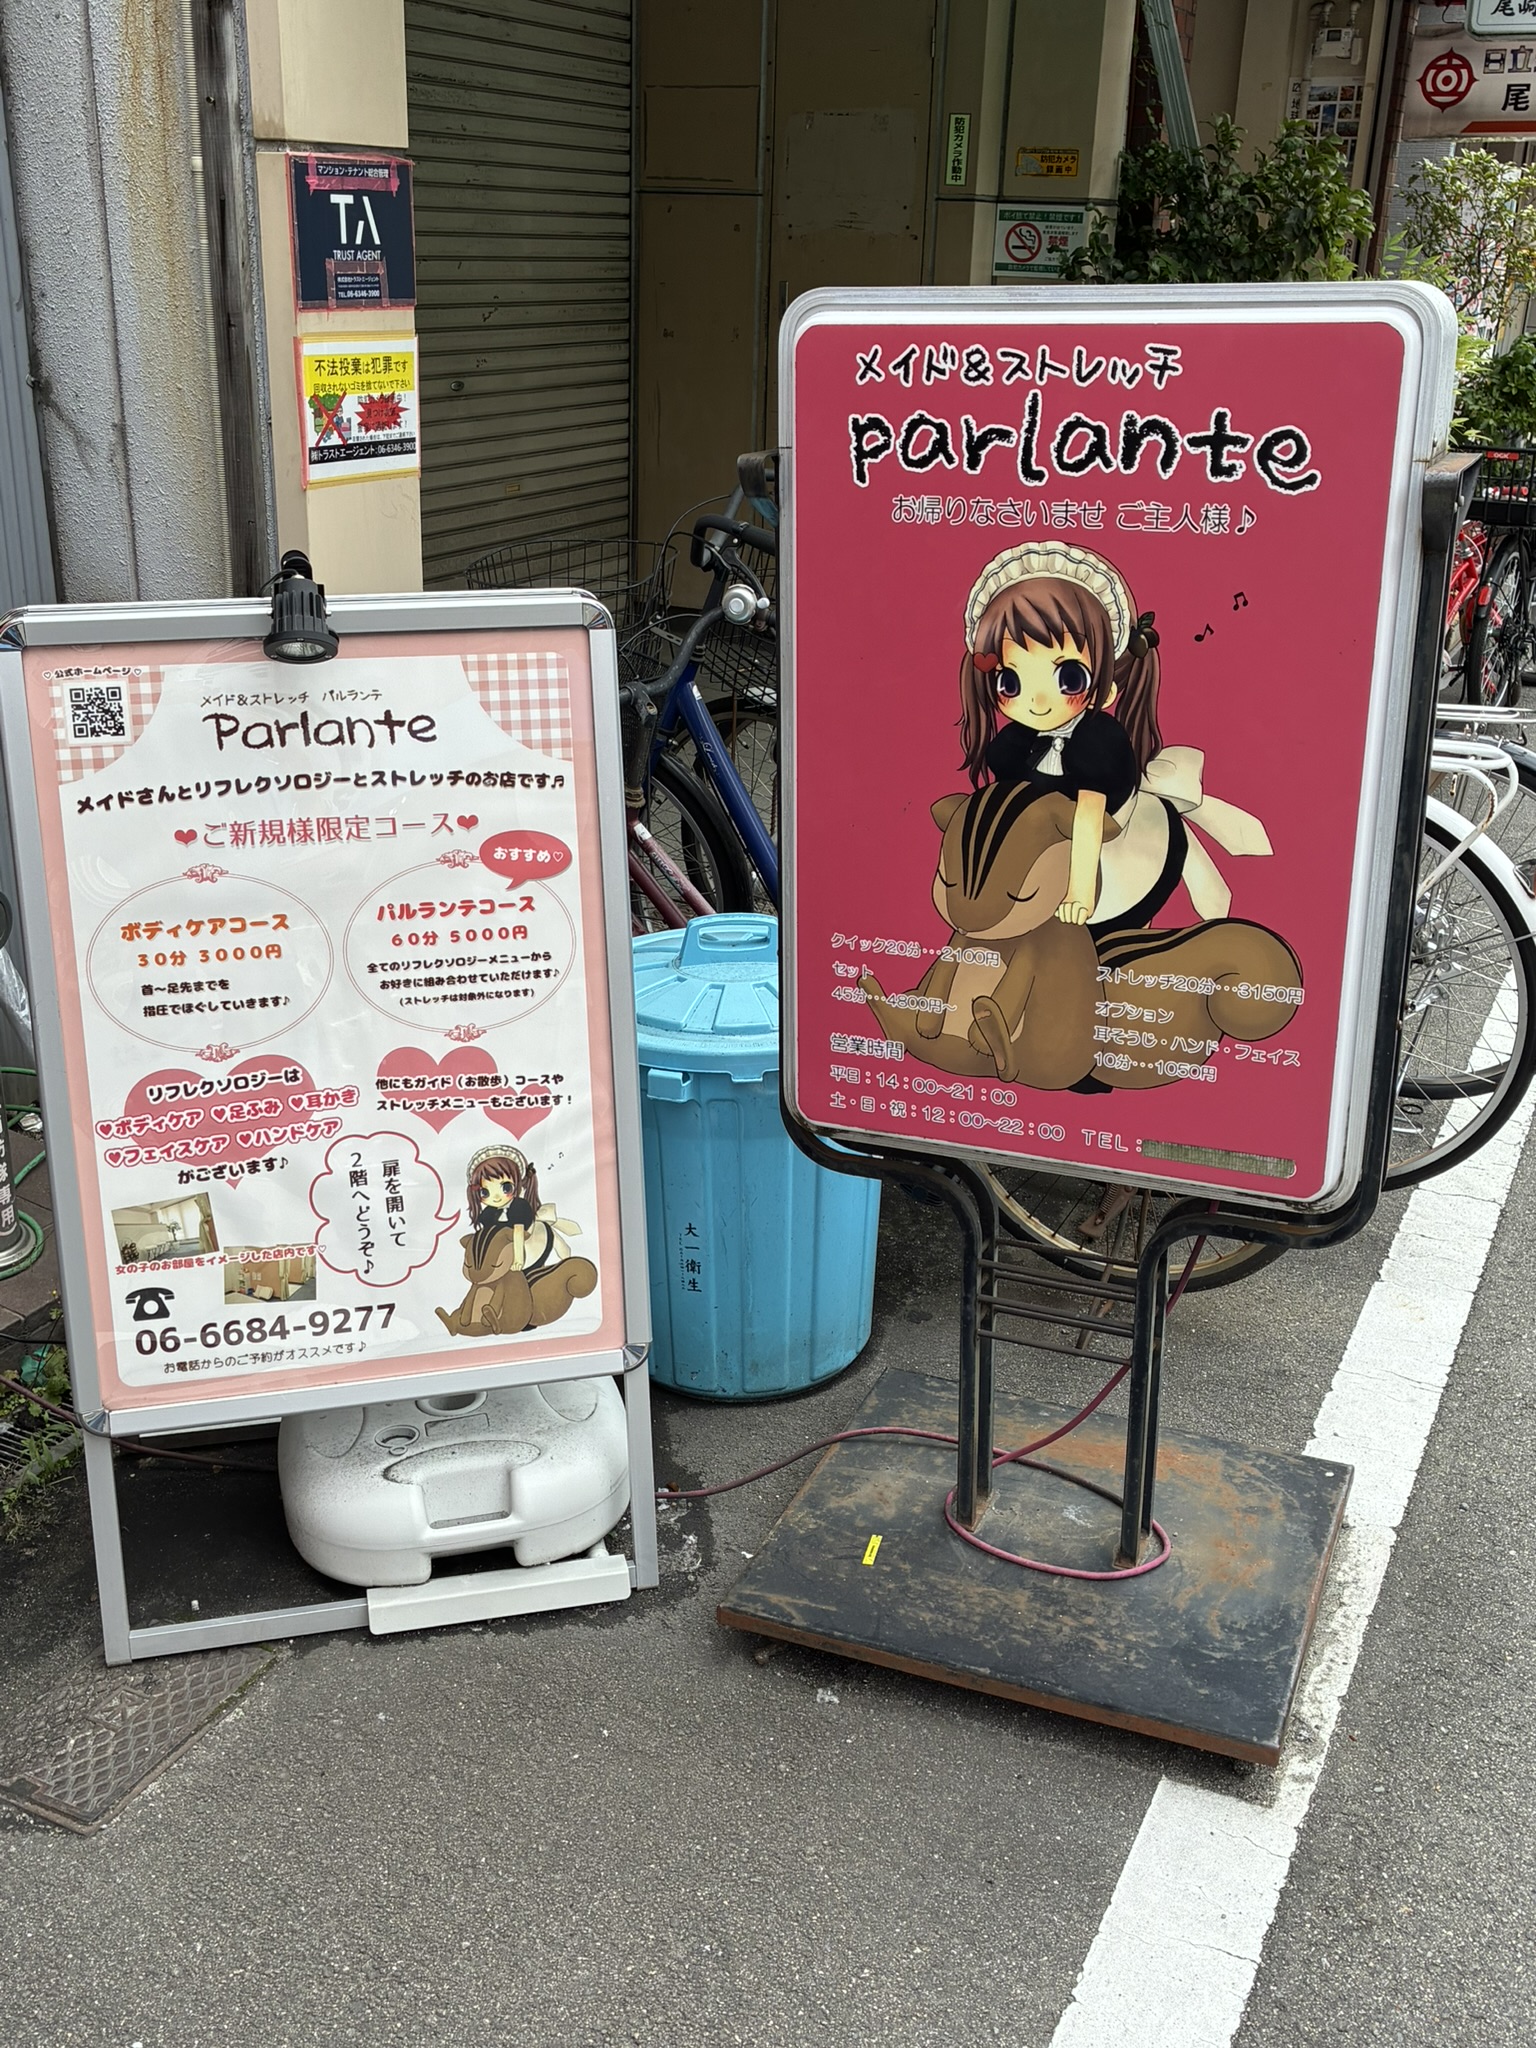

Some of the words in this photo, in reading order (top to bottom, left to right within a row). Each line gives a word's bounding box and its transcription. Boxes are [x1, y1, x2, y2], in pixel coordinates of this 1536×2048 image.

[1483, 45, 1536, 75] 日立
[951, 116, 966, 183] 防犯カメラ作動中
[1040, 154, 1077, 164] 防犯カメラ
[333, 250, 355, 261] TRUST
[356, 250, 382, 261] AGENT
[314, 356, 409, 377] 不法投棄は犯罪です
[855, 344, 1183, 390] メイド&ストレッチ
[848, 389, 1322, 495] parlante
[891, 494, 1106, 530] お帰りなさいませ
[54, 666, 132, 679] 公式ホームページ
[322, 689, 383, 703] パルランテ
[202, 709, 438, 752] Parlante
[202, 813, 455, 848] ご新規様限定コース
[493, 846, 550, 864] おすすめ
[376, 896, 536, 921] パルランテコース
[120, 914, 290, 942] ボディケアコース
[391, 930, 439, 948] 60分
[450, 925, 528, 944] 5000円
[137, 949, 188, 968] 30分
[199, 944, 283, 964] 3000円
[367, 951, 553, 974] 全てのリフレクソロジーメニューから
[832, 961, 875, 980] セット
[1095, 1001, 1175, 1024] オプション
[830, 1033, 905, 1061] 営業時間
[148, 1068, 301, 1102] リフレクソロジーは
[375, 1073, 564, 1090] 他にもガイド（お散歩）コースや
[114, 1110, 203, 1136] ボディケア
[229, 1100, 282, 1119] 足ふみ
[306, 1089, 358, 1109] 耳かき
[376, 1095, 572, 1111] ストレッチメニューもございます！
[124, 1137, 229, 1165] フェイスケア
[255, 1120, 341, 1144] ハンドケア
[381, 1159, 406, 1247] 扉を開いて
[684, 1222, 703, 1293] 大一衛生
[135, 1303, 397, 1356] 06-6684-9277
